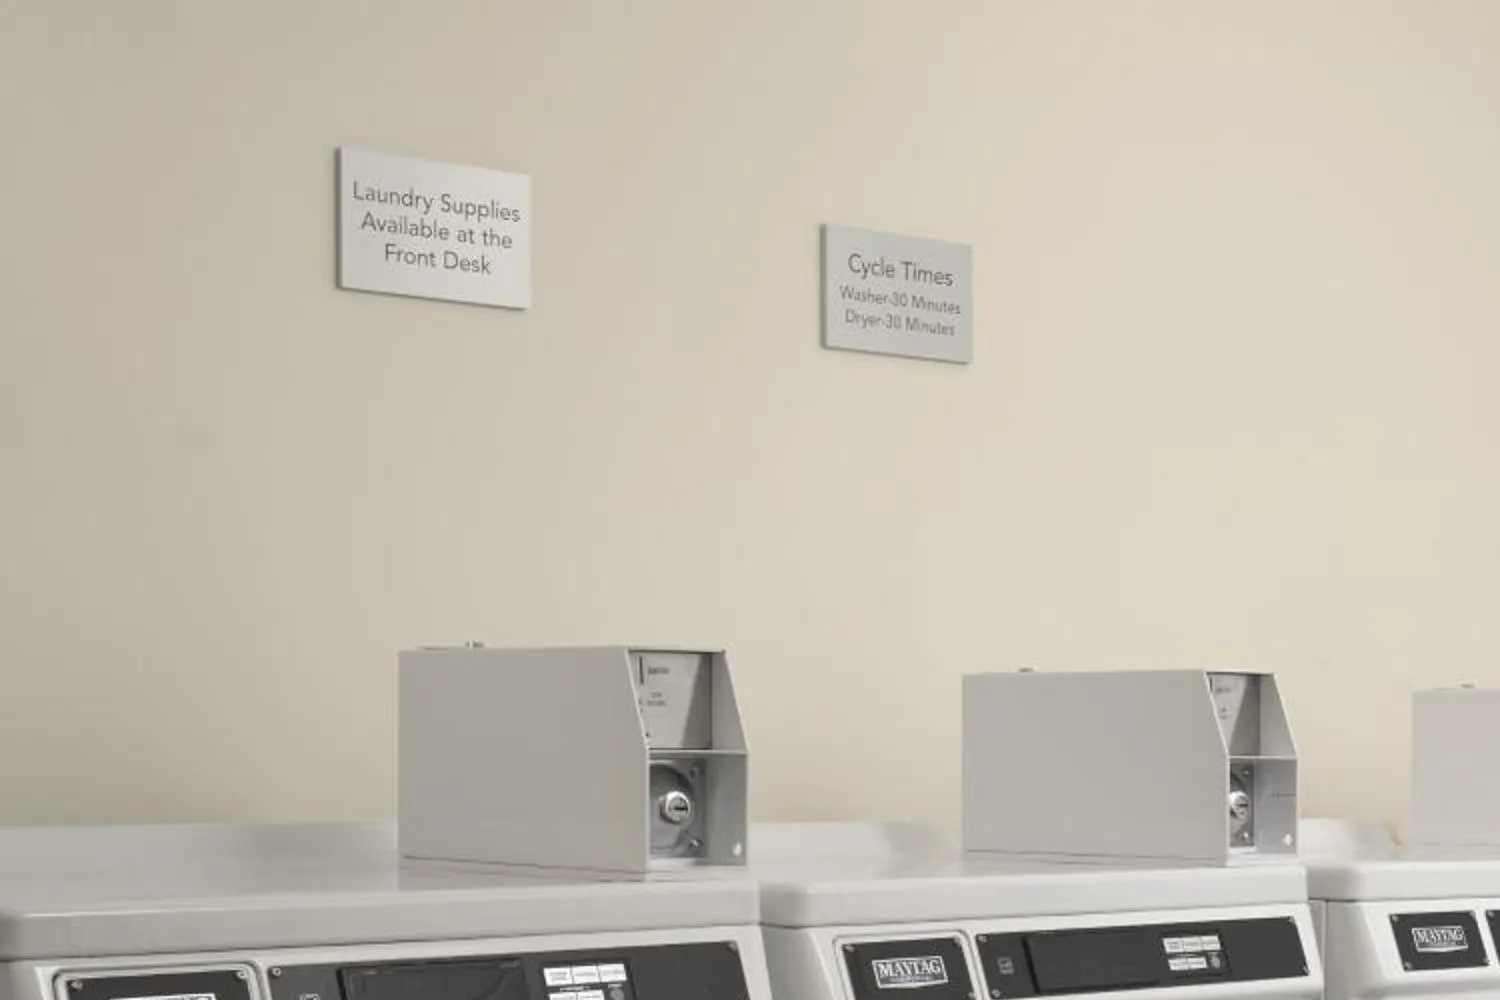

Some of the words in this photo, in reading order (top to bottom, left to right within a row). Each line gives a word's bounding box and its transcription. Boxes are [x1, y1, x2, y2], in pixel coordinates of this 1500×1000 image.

[353, 180, 434, 214] Laundry
[441, 193, 521, 222] Supplies
[361, 211, 449, 240] Available
[457, 228, 475, 244] at
[483, 228, 513, 249] the
[385, 243, 436, 267] Front
[443, 250, 492, 275] Desk
[848, 252, 896, 280] Cycle
[901, 260, 953, 286] Times
[911, 295, 961, 315] Minutes
[905, 316, 956, 336] Minutes
[877, 960, 941, 977] MAYTAG
